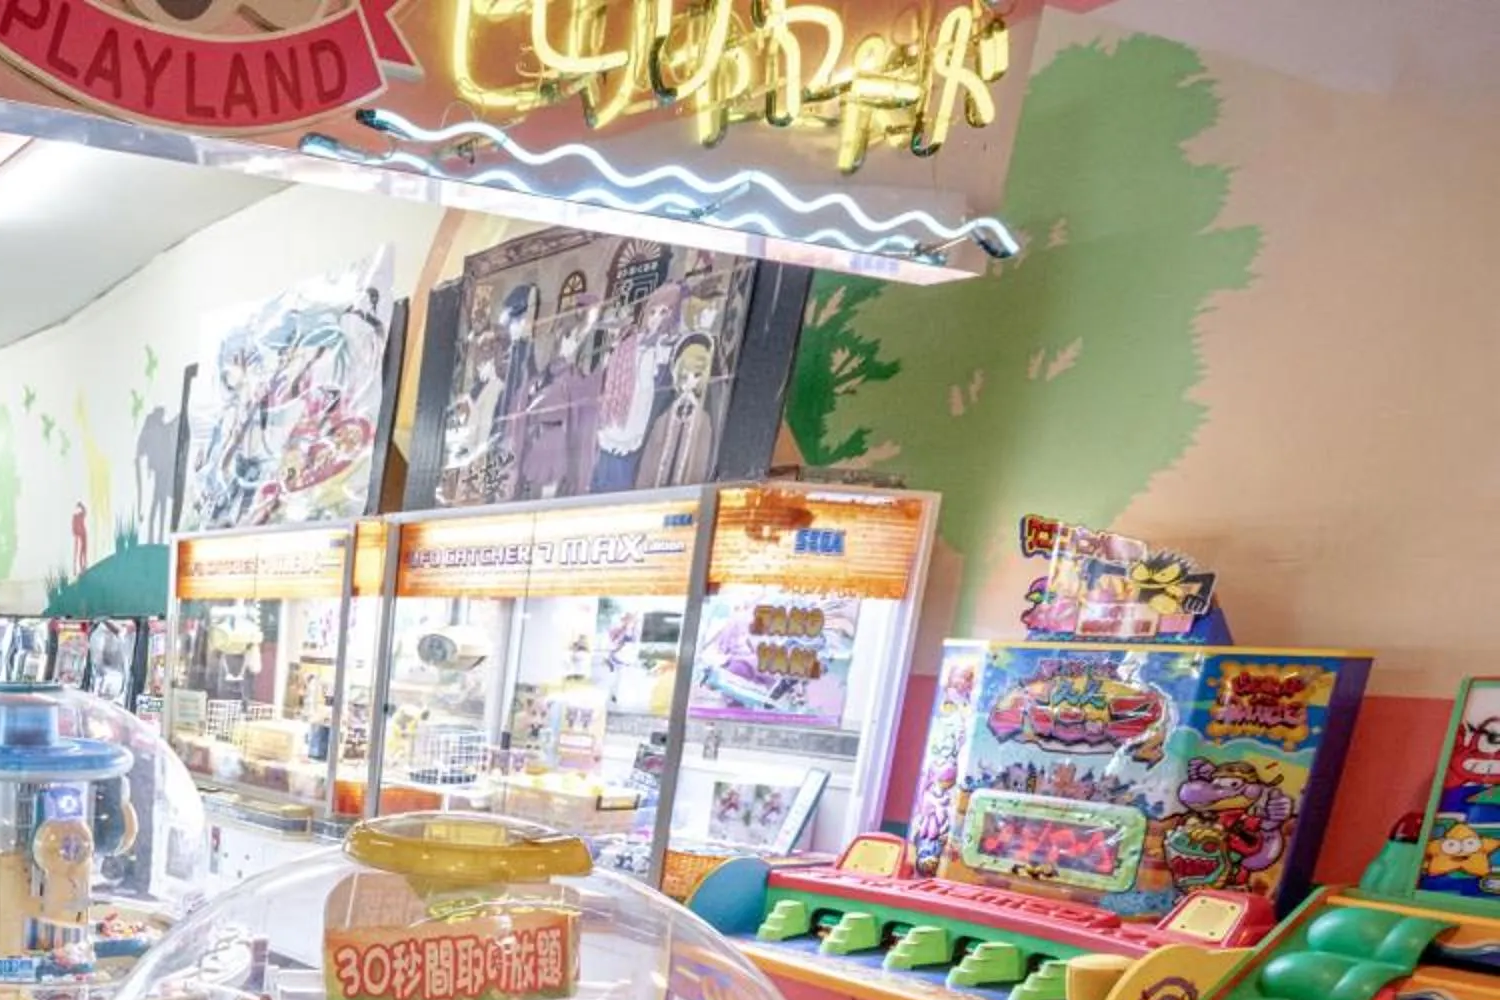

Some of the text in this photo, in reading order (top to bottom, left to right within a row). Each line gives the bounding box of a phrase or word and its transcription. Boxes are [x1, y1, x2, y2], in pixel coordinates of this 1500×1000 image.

[2, 0, 347, 119] PLAYLAND
[560, 533, 645, 565] MAX
[794, 528, 846, 556] SEGA
